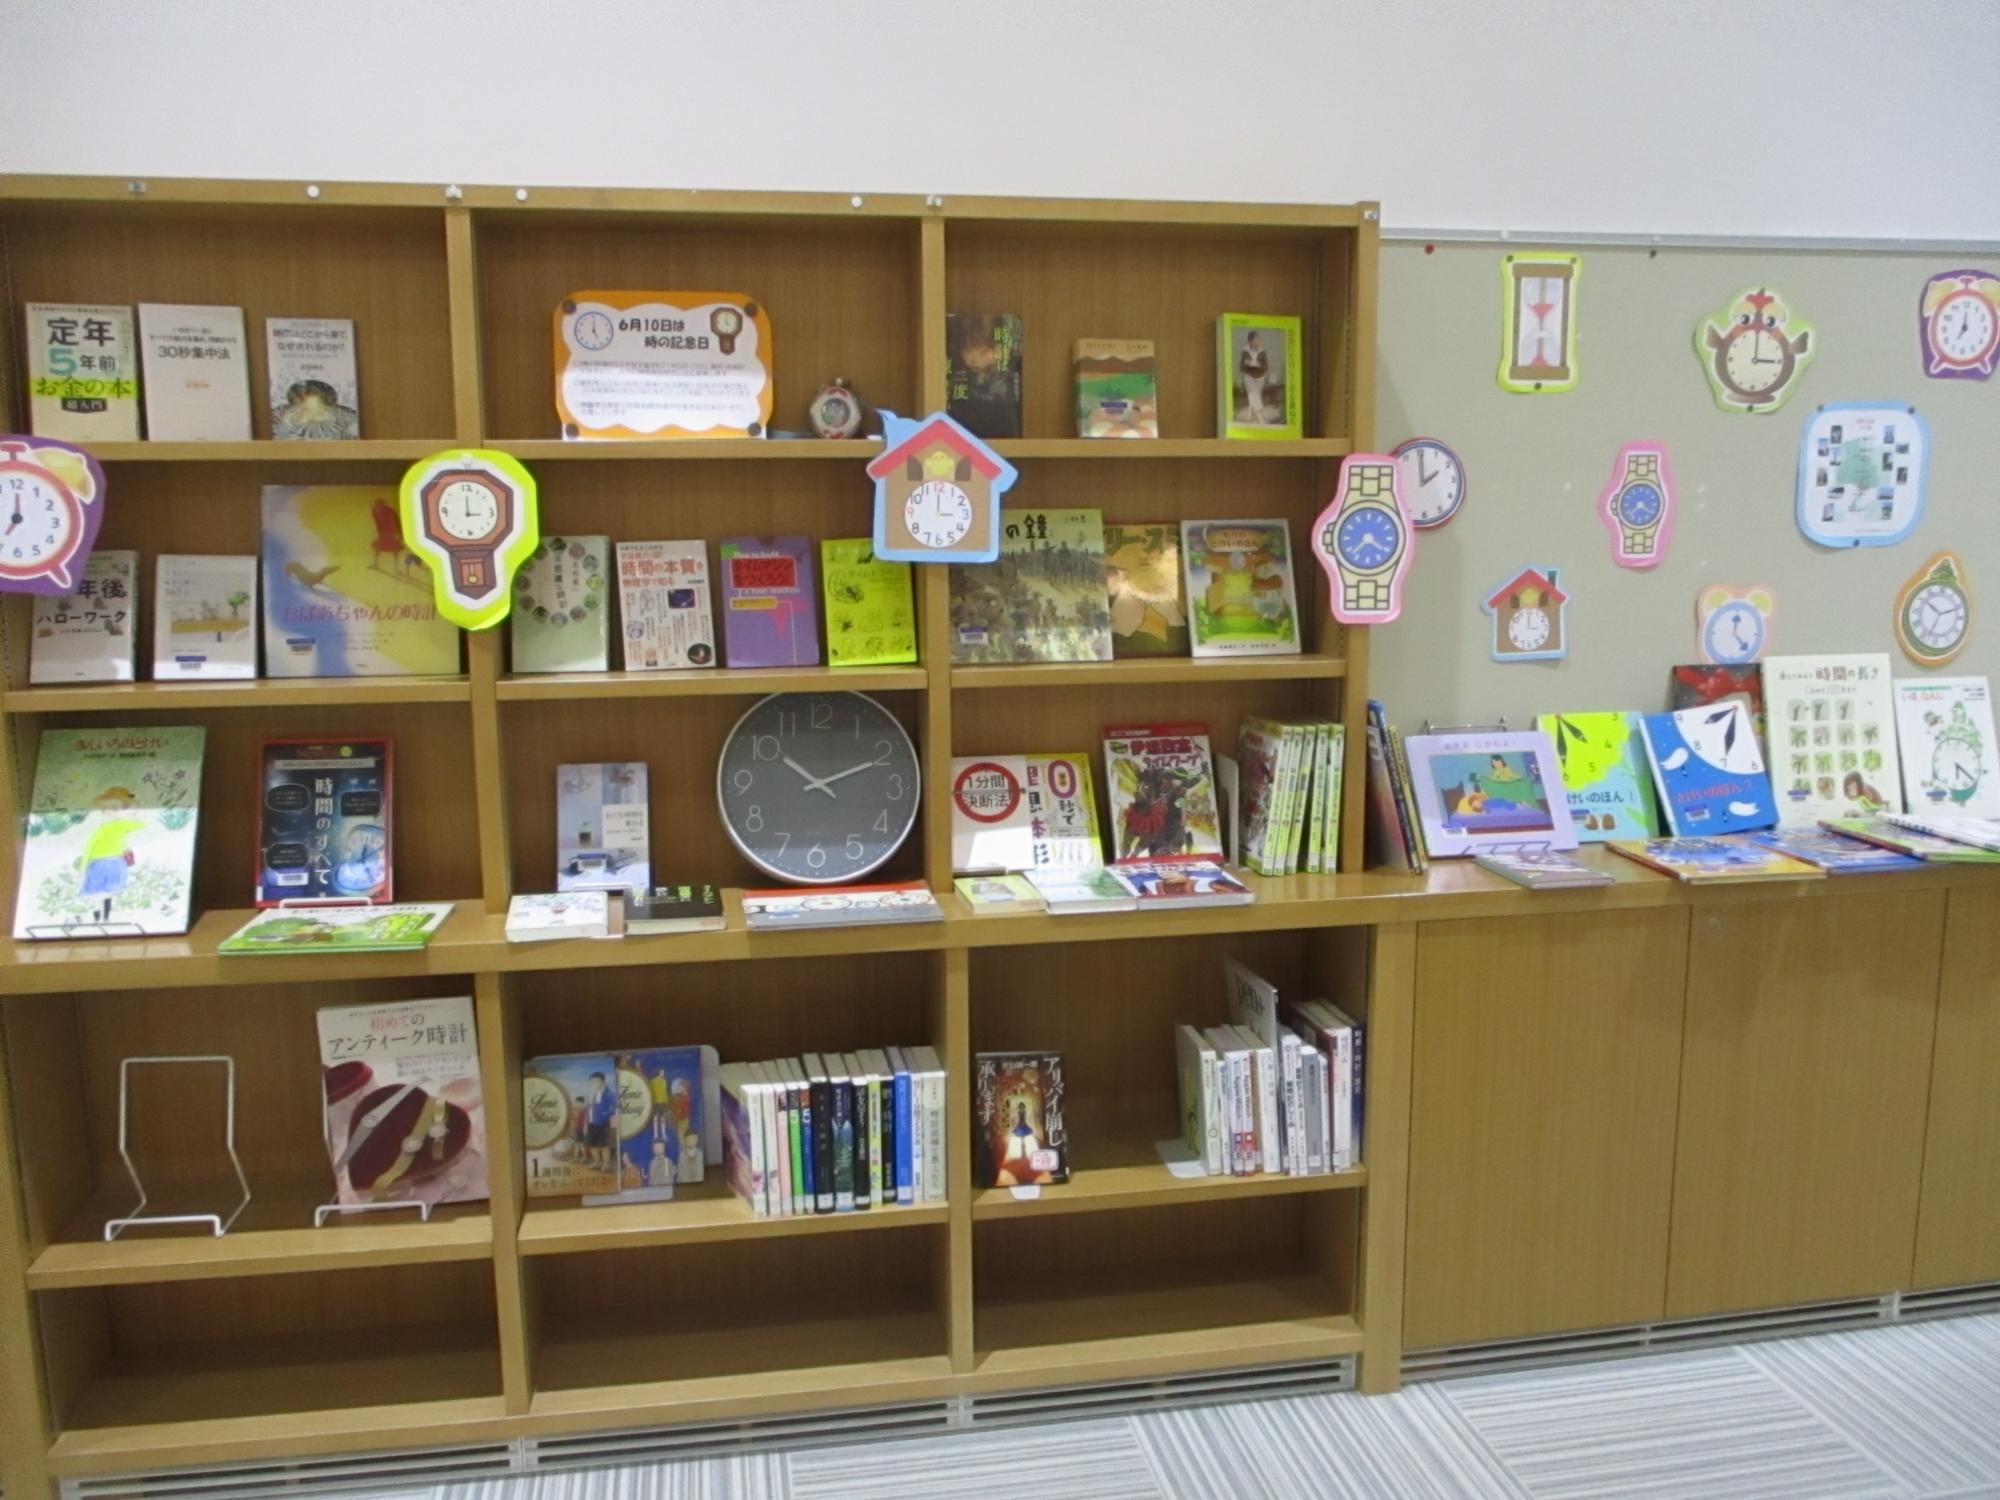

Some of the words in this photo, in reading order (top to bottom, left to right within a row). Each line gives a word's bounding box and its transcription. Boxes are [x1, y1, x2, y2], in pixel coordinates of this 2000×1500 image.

[47, 317, 116, 347] 定年
[618, 319, 685, 332] 6月10日は
[644, 336, 710, 350] 時の記念日
[48, 347, 116, 377] 5年前
[36, 376, 131, 399] お金の本
[10, 479, 24, 490] 12
[921, 485, 930, 497] 11
[933, 482, 946, 494] 12
[33, 486, 40, 498] 1
[951, 487, 955, 498] 1
[45, 500, 54, 512] 2
[909, 494, 923, 505] 10
[957, 495, 966, 507] 2
[907, 506, 914, 518] 9
[962, 508, 970, 521] 3
[51, 517, 61, 529] 3
[912, 522, 920, 535] 8
[956, 522, 965, 534] 4
[45, 535, 55, 545] 4
[923, 532, 932, 545] 7
[935, 533, 943, 546] 6
[946, 532, 956, 544] 5
[13, 547, 23, 559] 6
[32, 545, 42, 556] 5
[621, 559, 705, 577] 時間の本質を
[37, 611, 127, 624] ハローワーク
[811, 703, 833, 730] 12
[1612, 713, 1618, 721] 3
[1676, 713, 1684, 723] 9
[778, 711, 797, 737] 11
[855, 714, 860, 740] 1
[751, 735, 780, 761] 10
[1604, 738, 1612, 749] 4
[1693, 740, 1702, 750] 8
[873, 740, 893, 766] 2
[1588, 761, 1596, 772] 5
[1720, 758, 1727, 768] 7
[1751, 760, 1758, 770] 6
[734, 769, 753, 796] 9
[967, 775, 1006, 789] 1分間
[1563, 772, 1570, 782] 6
[886, 774, 903, 800] 3
[965, 793, 1010, 809] 決断法
[746, 804, 764, 833] 8
[872, 808, 889, 833] 4
[315, 778, 334, 885] 時間のすべて
[774, 832, 791, 858] 7
[845, 834, 864, 860] 5
[806, 842, 826, 868] 6
[369, 1013, 425, 1031] 初めての
[329, 1023, 469, 1053] アンティーク時計
[977, 1060, 997, 1126] 承ります
[1043, 1057, 1065, 1147] アリバイ崩し
